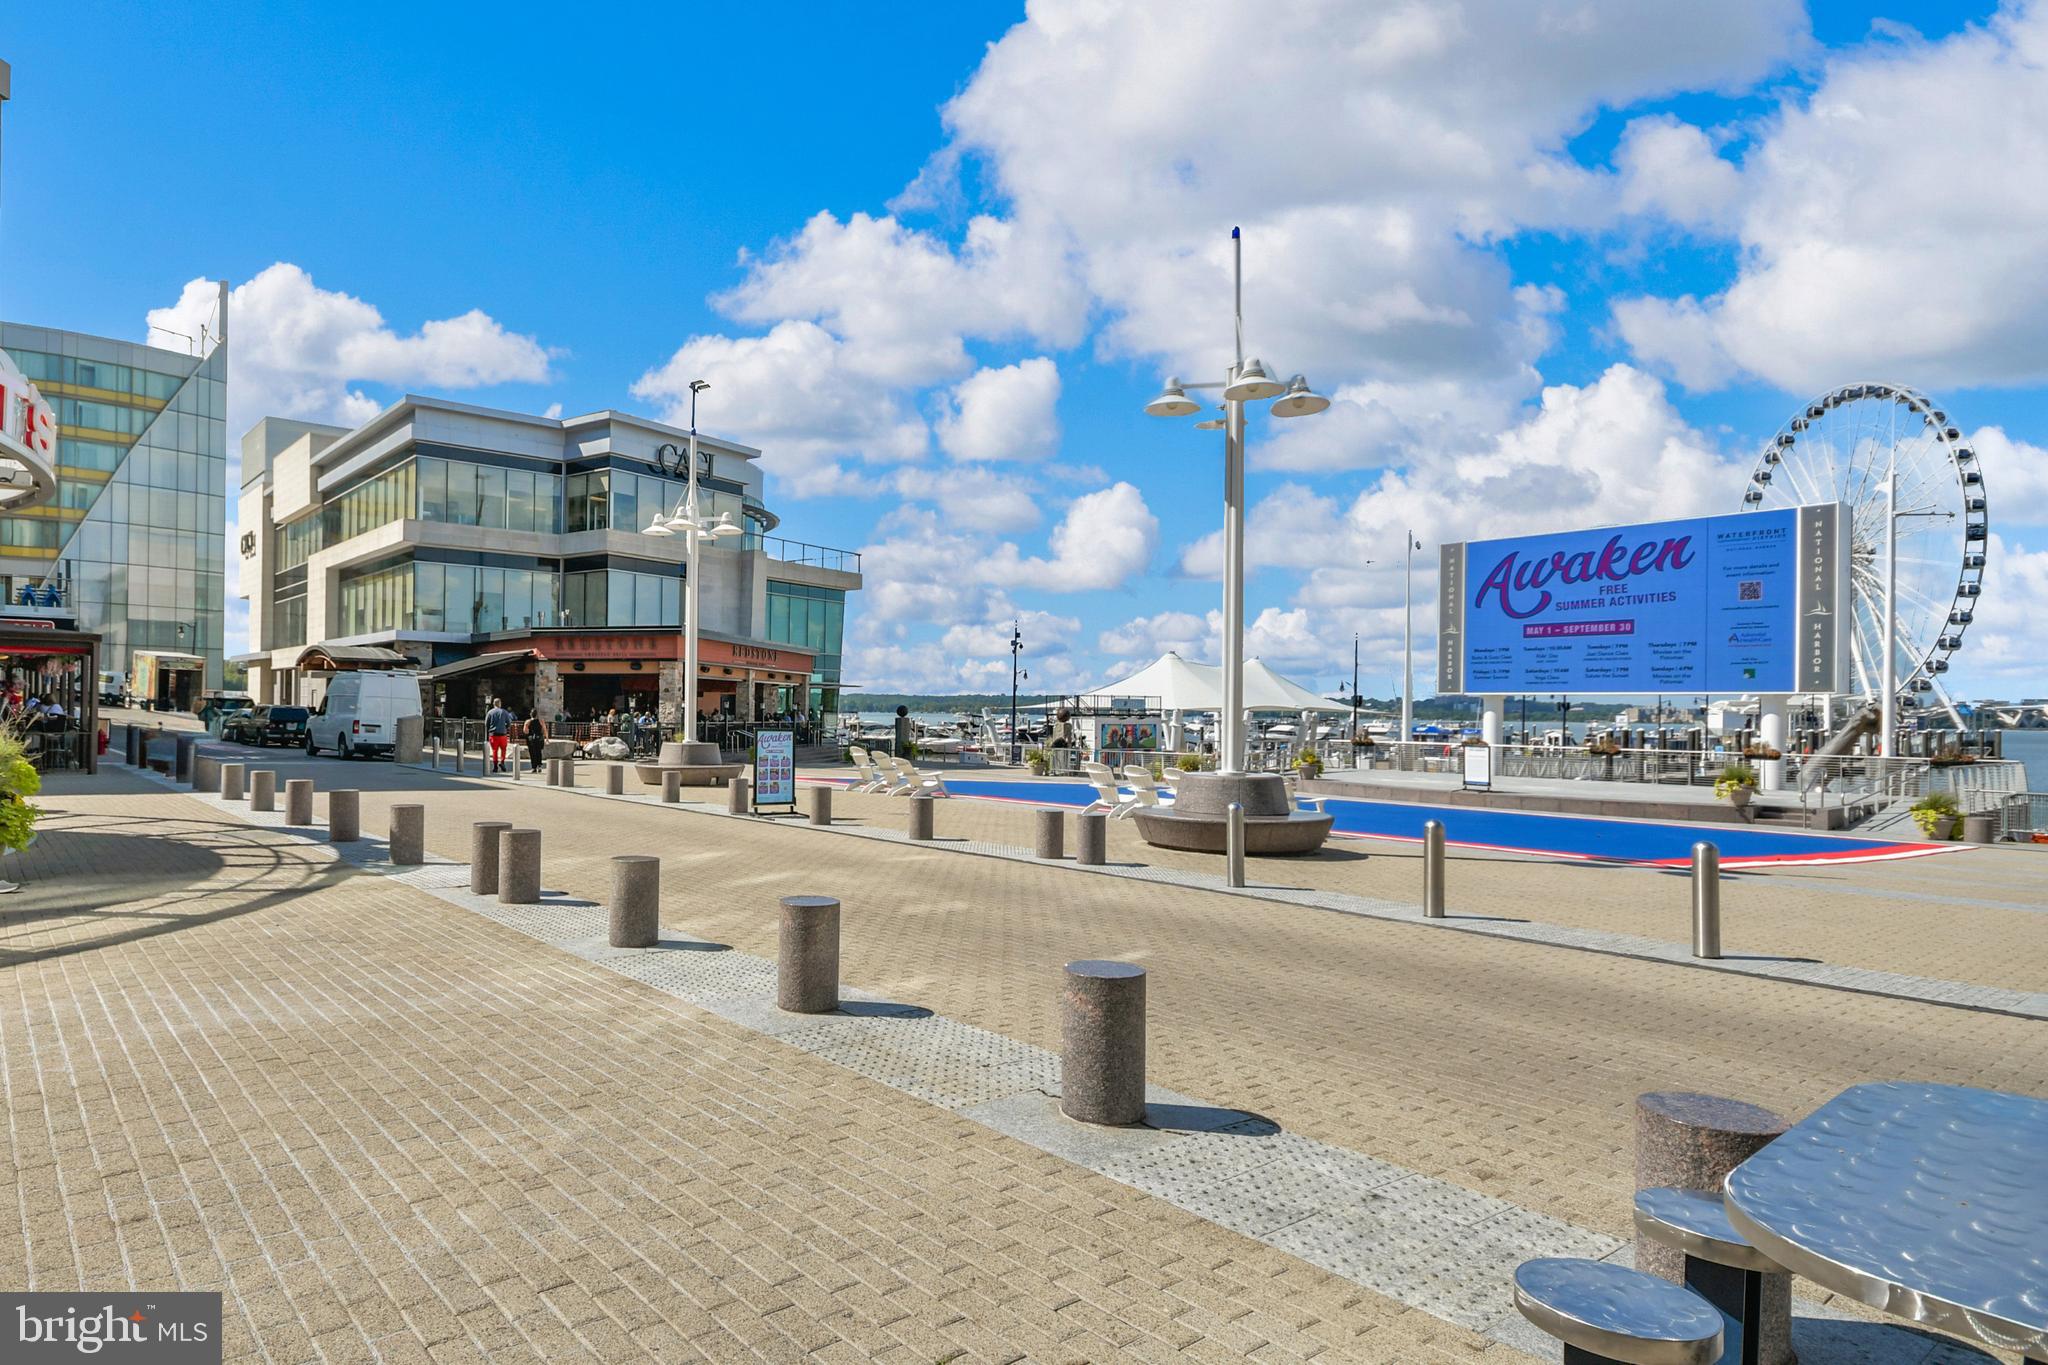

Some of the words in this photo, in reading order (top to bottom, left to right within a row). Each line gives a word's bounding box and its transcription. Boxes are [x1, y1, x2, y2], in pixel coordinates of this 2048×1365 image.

[1717, 527, 1788, 540] WATERFRONT
[1813, 520, 1823, 591] NATIONAL
[1475, 534, 1696, 619] Awaken
[1448, 558, 1456, 615] NATIONAL
[1599, 583, 1629, 596] FREE
[1555, 598, 1605, 612] SUMMER
[1609, 591, 1677, 607] ACTIVITIES
[1526, 626, 1544, 635] MAY
[1547, 626, 1552, 634] 1
[1563, 623, 1617, 634] SEPTEMBER
[1619, 622, 1632, 632] 30
[554, 636, 658, 651] REDSTONE
[1812, 623, 1822, 673] HARBOR
[732, 645, 777, 662] REDSTONE
[758, 732, 793, 749] Awaken
